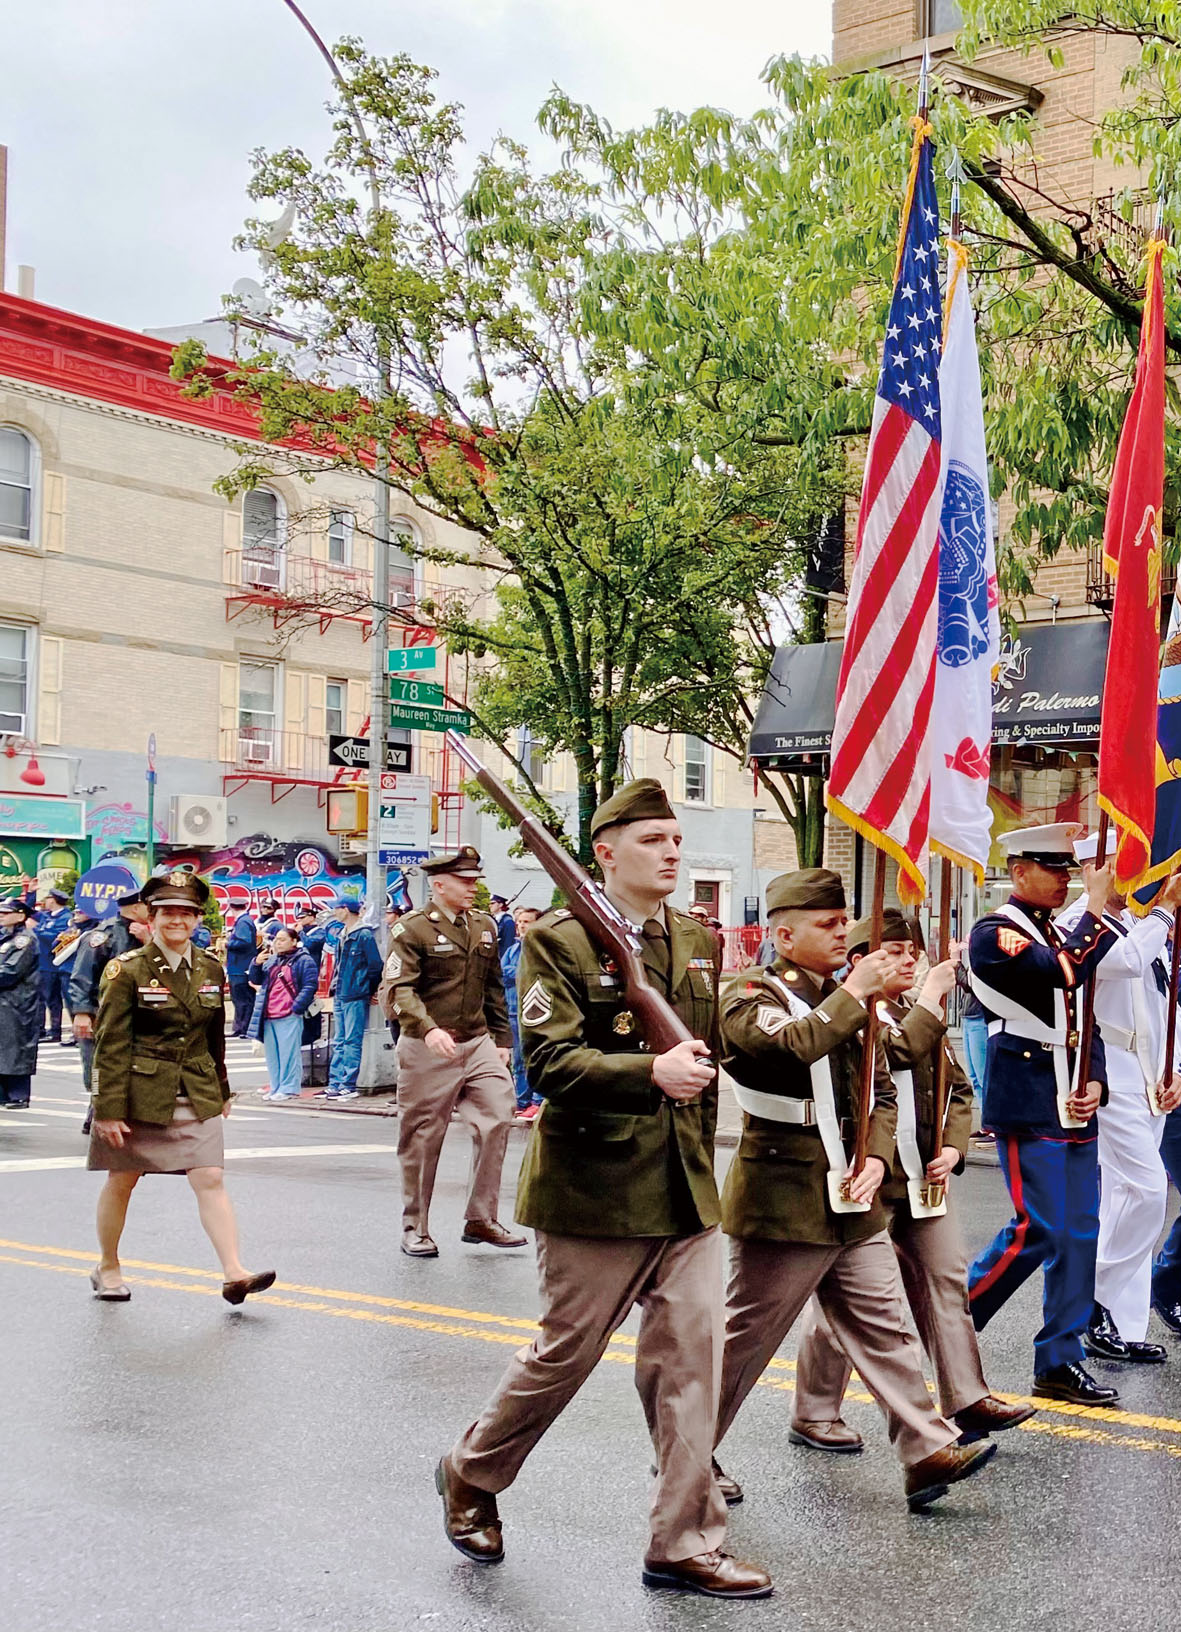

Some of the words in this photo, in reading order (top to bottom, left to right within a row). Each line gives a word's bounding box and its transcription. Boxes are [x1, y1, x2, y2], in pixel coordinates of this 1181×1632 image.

[400, 651, 408, 669] 3
[399, 682, 418, 700] 78
[1016, 691, 1100, 713] Palermo
[392, 705, 430, 721] Maureen
[432, 710, 468, 726] Stramka
[1012, 724, 1022, 736] &
[1024, 722, 1070, 738] Specialty
[1072, 721, 1102, 736] Impo
[775, 736, 793, 748] The
[794, 735, 823, 747] Finest
[342, 745, 366, 760] ONE
[387, 751, 402, 763] AY
[383, 805, 393, 818] 2
[386, 855, 417, 865] 306852
[39, 871, 65, 882] JAME
